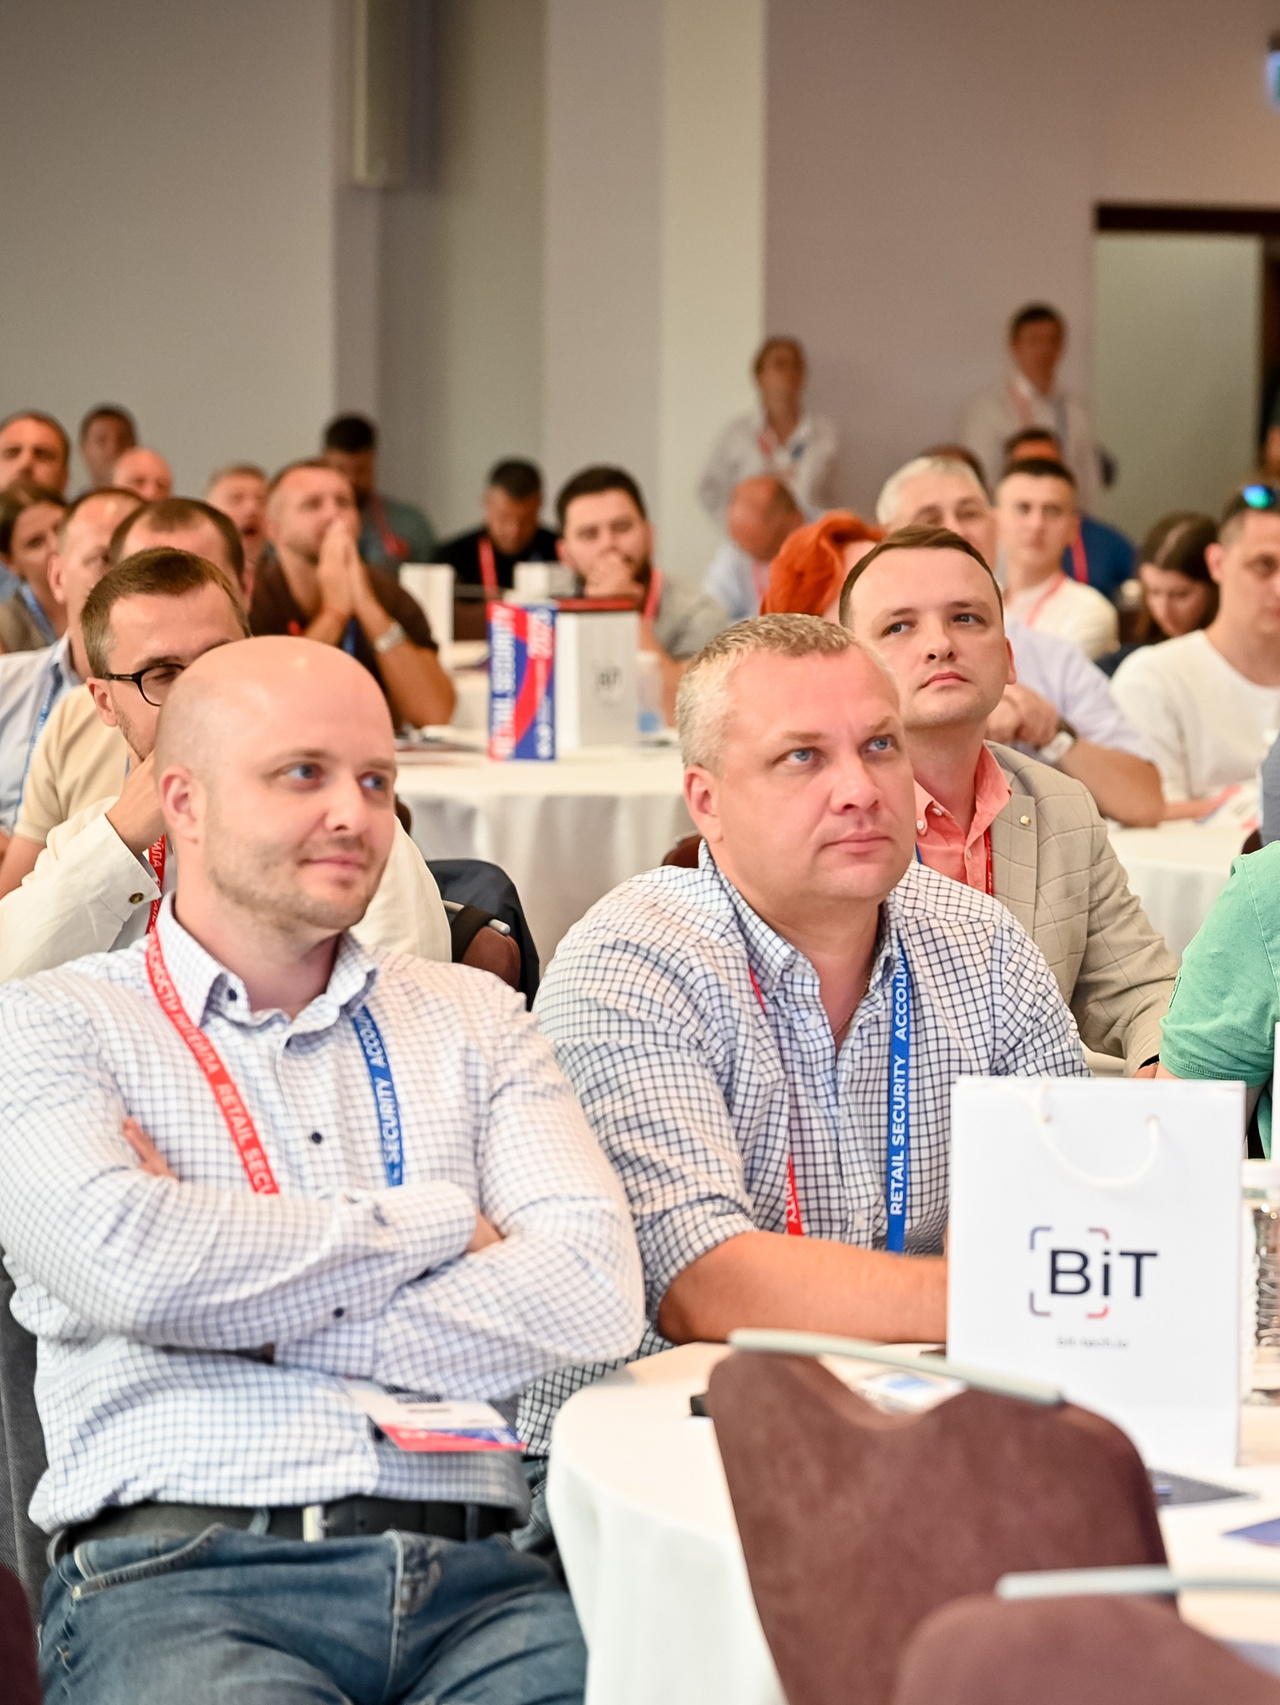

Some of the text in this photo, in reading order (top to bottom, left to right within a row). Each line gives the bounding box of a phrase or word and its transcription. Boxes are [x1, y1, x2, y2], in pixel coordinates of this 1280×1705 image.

[374, 1077, 401, 1165] SECURITY
[890, 1054, 906, 1216] RETAIL SECURITY
[1050, 1249, 1158, 1297] BiT
